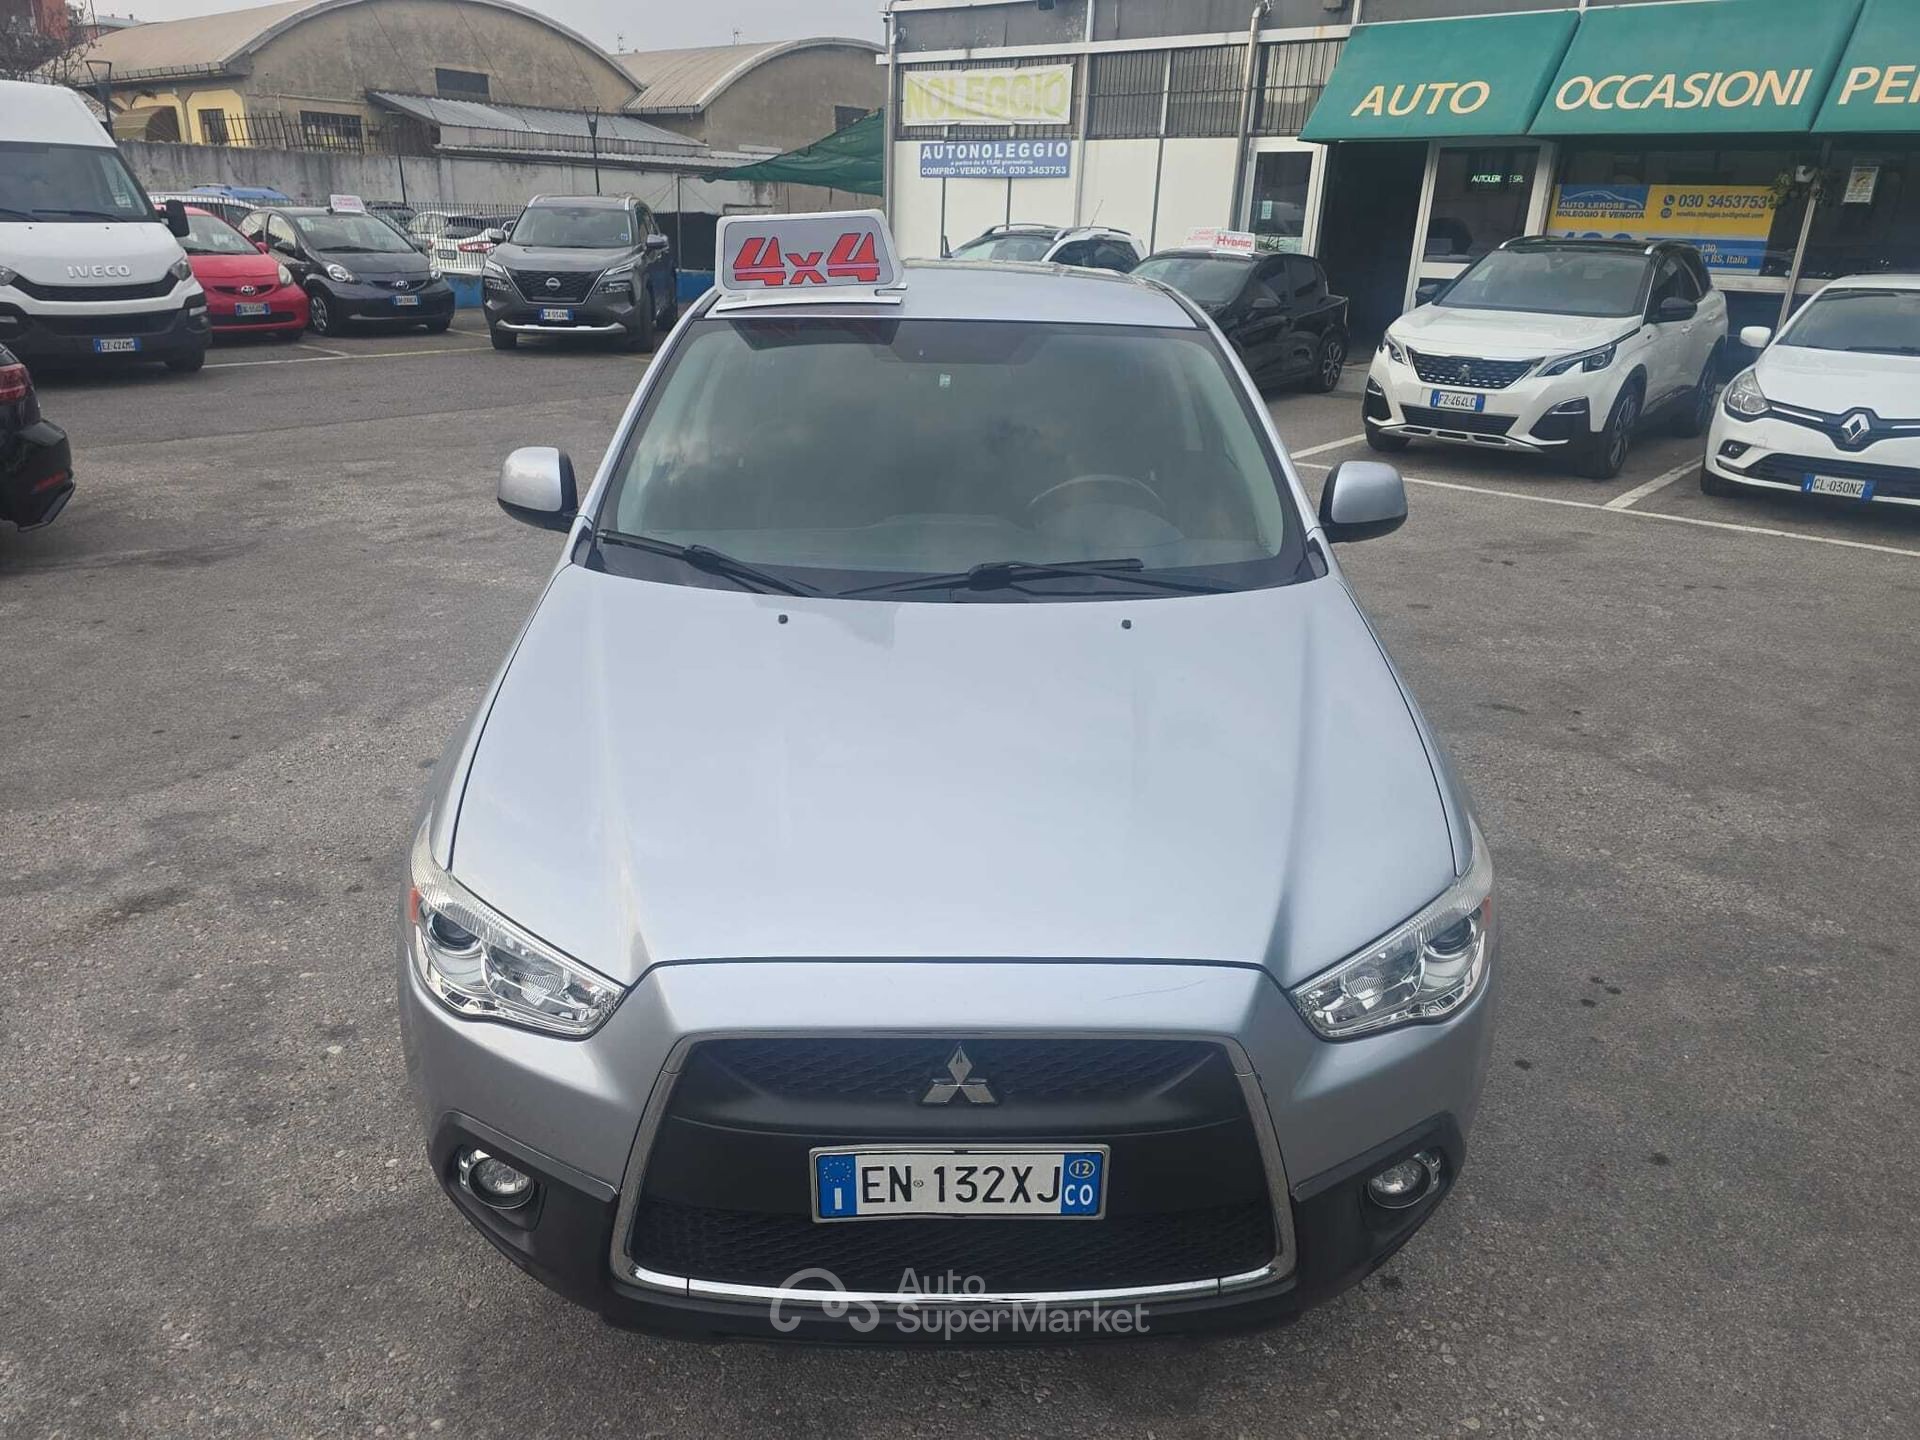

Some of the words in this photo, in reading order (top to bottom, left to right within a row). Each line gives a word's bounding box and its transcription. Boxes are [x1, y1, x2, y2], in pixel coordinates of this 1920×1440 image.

[905, 70, 1067, 118] NOLEGGIO
[1351, 80, 1490, 117] AUTO
[1556, 68, 1813, 111] OCCASIONI
[1838, 65, 1920, 105] PE
[922, 142, 1068, 160] AUTONOLEGGIO
[921, 166, 956, 176] COMPRO
[959, 166, 988, 175] VENDO
[1009, 165, 1026, 175] 030
[1027, 164, 1067, 175] 3453753
[1560, 201, 1585, 209] AUTO
[1678, 194, 1703, 208] 030
[1707, 194, 1767, 209] 3453753
[1556, 210, 1599, 218] NOLEGGIO
[1608, 211, 1645, 219] VENDITA
[66, 264, 131, 278] IVECO
[861, 1165, 912, 1203] EN
[933, 1165, 1061, 1203] 132XJ
[1074, 1162, 1091, 1175] 12
[1064, 1184, 1094, 1206] CO
